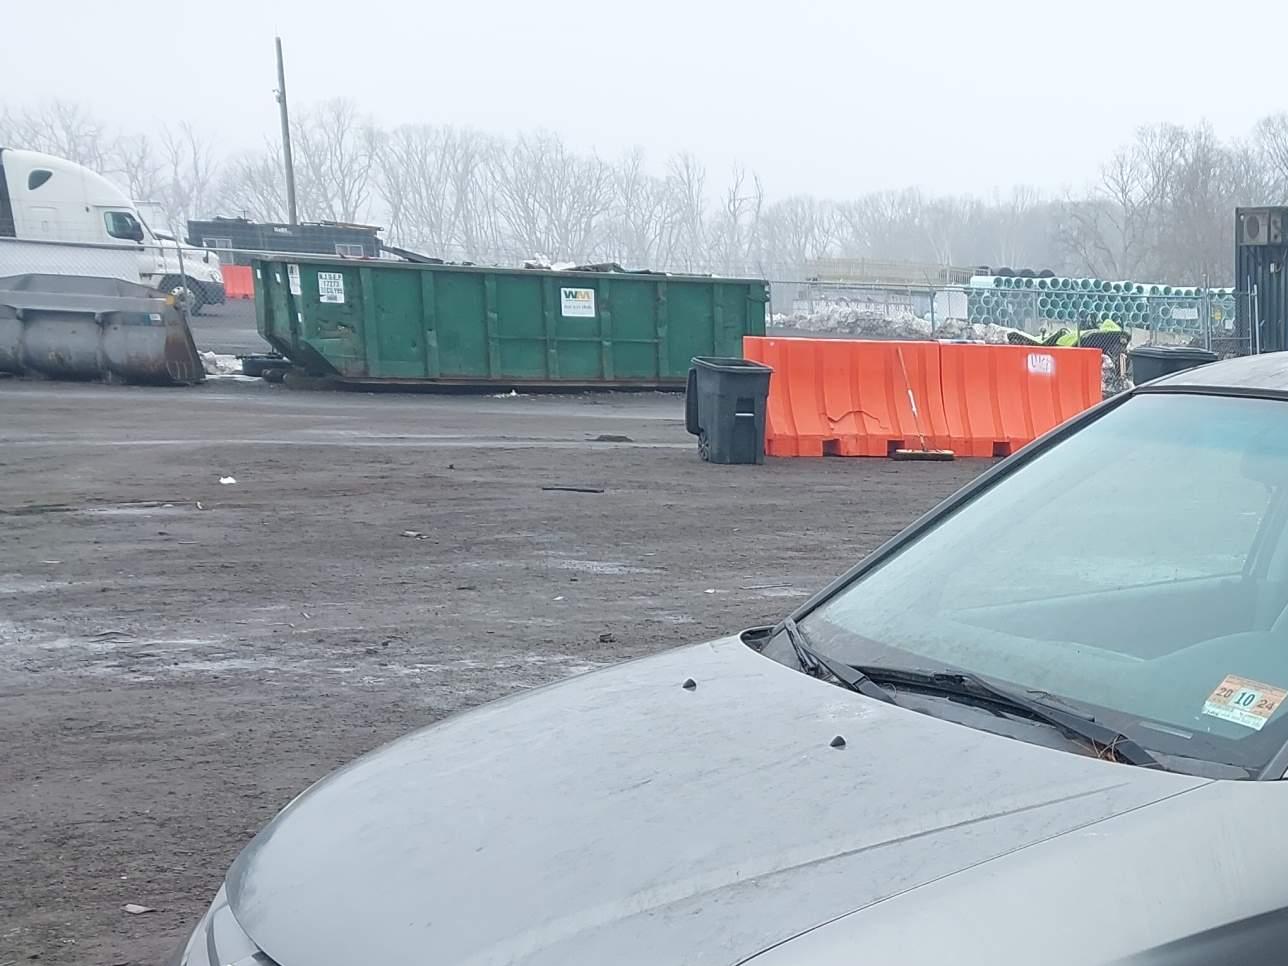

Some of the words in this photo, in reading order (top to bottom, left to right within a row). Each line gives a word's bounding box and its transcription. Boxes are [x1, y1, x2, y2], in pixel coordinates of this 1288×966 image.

[563, 290, 593, 299] WM
[1216, 687, 1234, 698] 20
[1234, 691, 1256, 707] 10
[1257, 699, 1275, 711] 24
